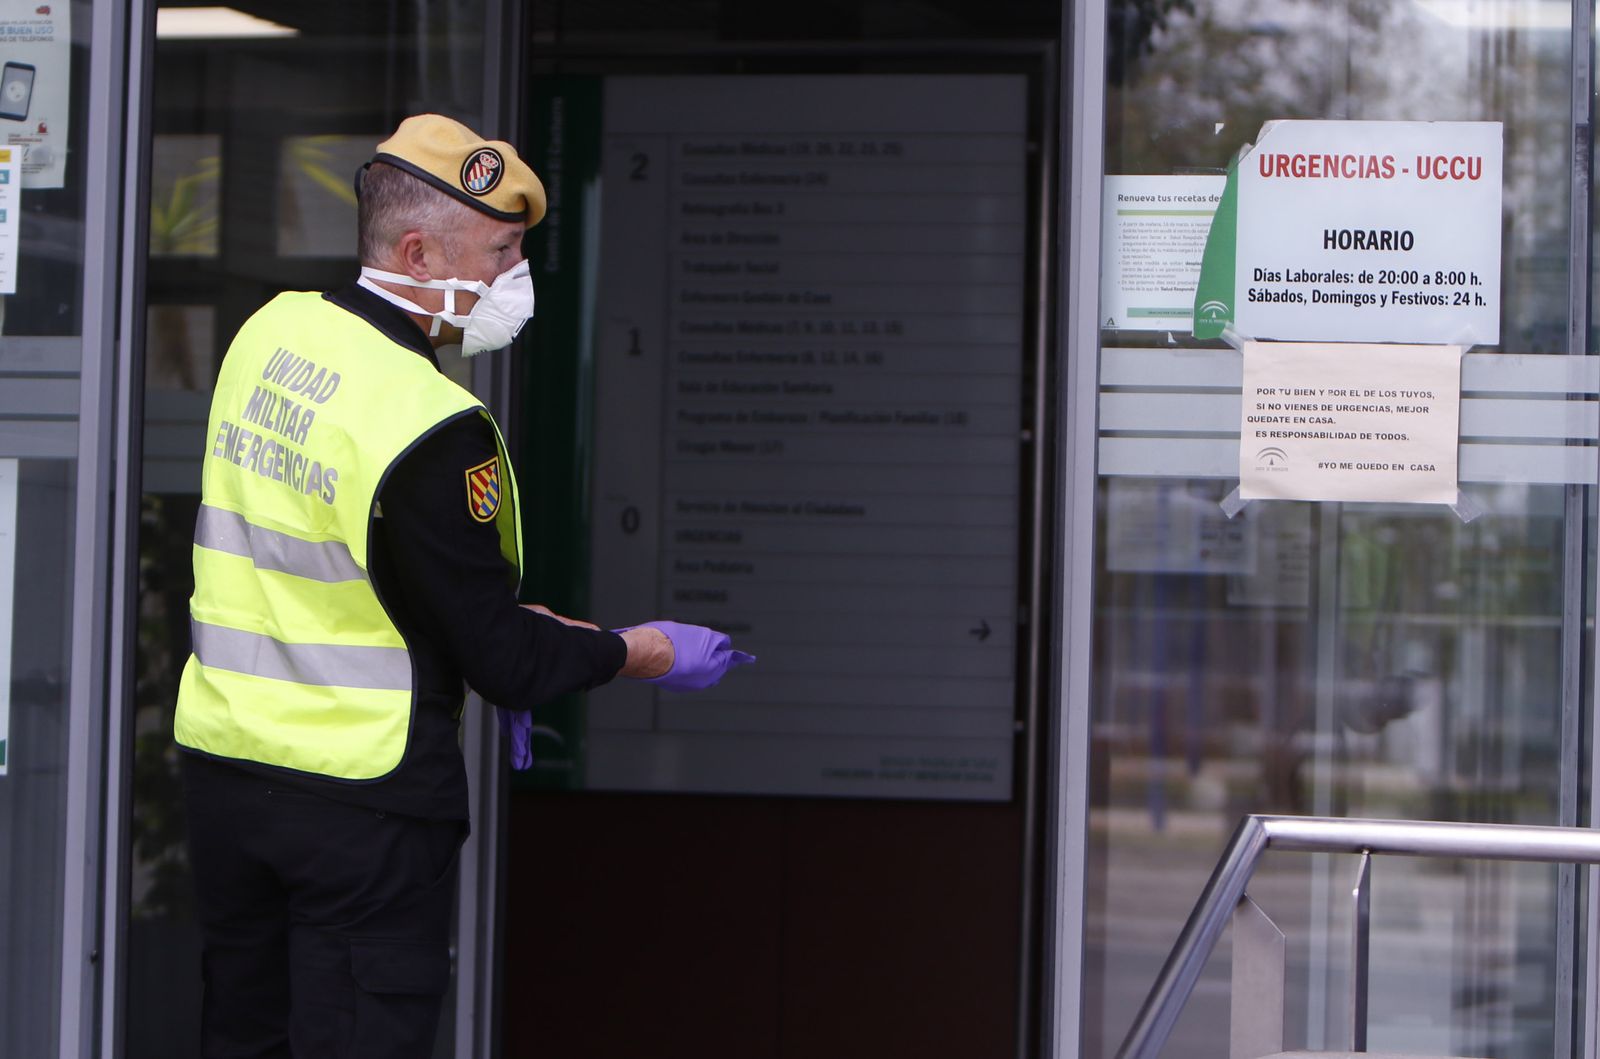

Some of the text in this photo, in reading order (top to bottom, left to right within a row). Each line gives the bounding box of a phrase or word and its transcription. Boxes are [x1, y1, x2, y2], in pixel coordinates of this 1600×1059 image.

[631, 153, 649, 180] 2
[1259, 154, 1396, 179] URGENCIAS
[1417, 156, 1482, 180] UCCU
[1118, 194, 1155, 202] Renueva
[1174, 194, 1206, 203] recetas
[1323, 229, 1415, 251] HORARIO
[1254, 267, 1483, 286] Días Laborales: de 20:00 a 8:00 h.
[1248, 287, 1487, 308] Sábados, Domingos y Festivos: 24 h.
[627, 326, 643, 357] 1
[262, 347, 341, 405] UNIDAD
[1256, 388, 1276, 396] POR
[1279, 388, 1291, 396] TU
[1294, 389, 1316, 397] BIEN
[1319, 389, 1325, 397] Y
[1328, 389, 1346, 397] POR
[1400, 391, 1435, 400] TUYOS,
[242, 385, 316, 446] MILITAR
[1256, 403, 1430, 414] SI NO VIENES DE URGENCIAS, MEJOR
[1247, 416, 1337, 425] QUEDATE EN CASA.
[1270, 431, 1357, 440] RESPONSABILIDAD
[1360, 432, 1372, 440] DE
[1375, 433, 1410, 441] TODOS.
[213, 420, 338, 505] EMERGENCIAS
[1318, 462, 1337, 470] #YO
[1339, 462, 1353, 470] ME
[1356, 463, 1389, 471] QUEDO
[1410, 464, 1436, 472] CASA
[621, 505, 640, 535] 0
